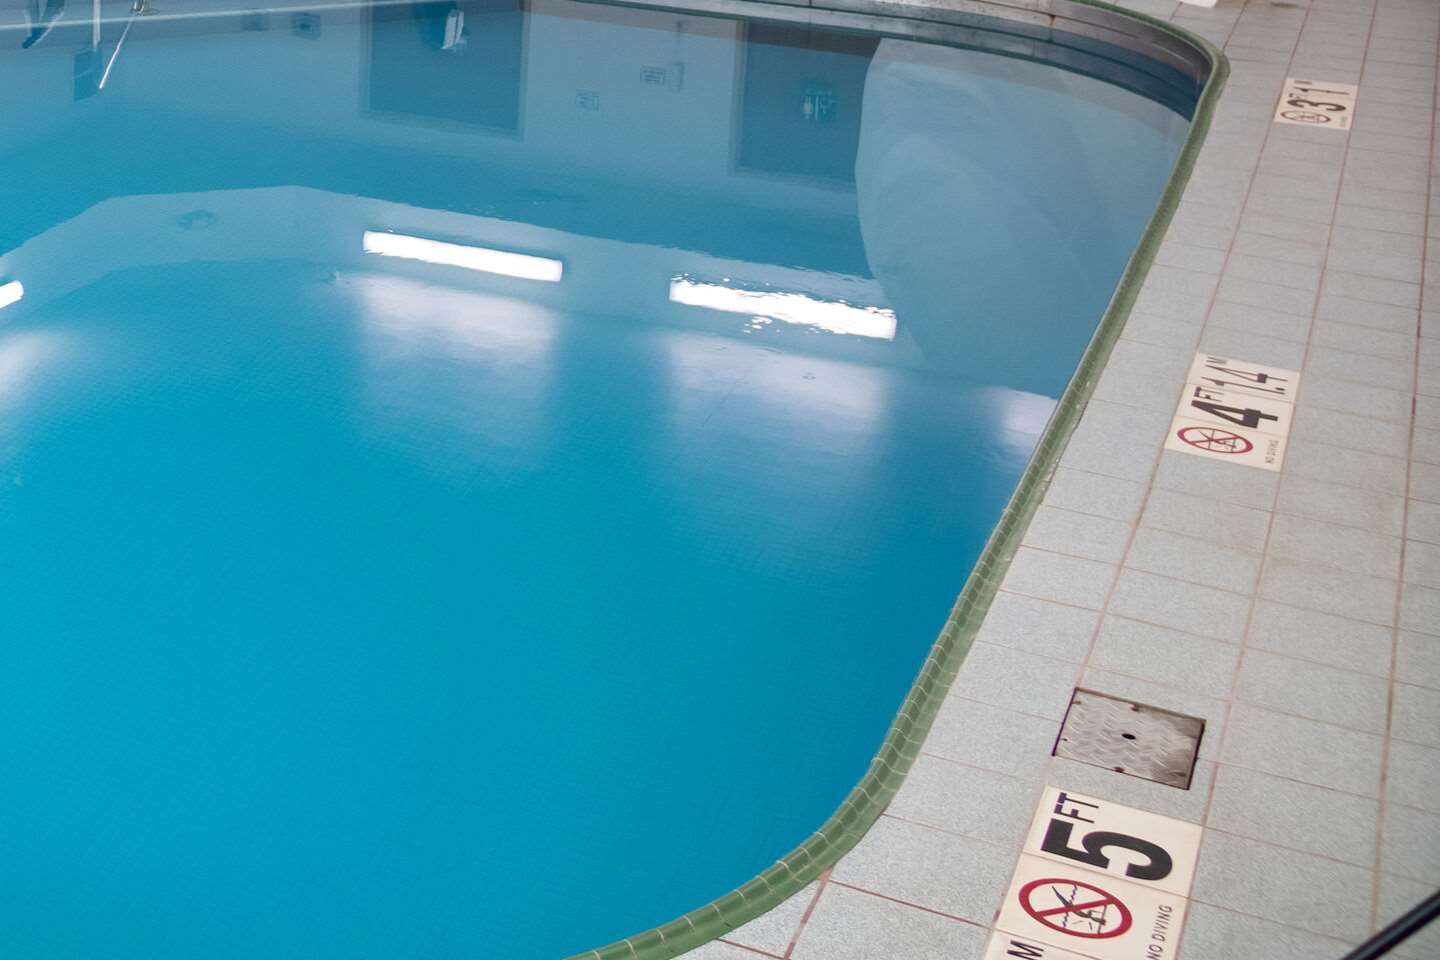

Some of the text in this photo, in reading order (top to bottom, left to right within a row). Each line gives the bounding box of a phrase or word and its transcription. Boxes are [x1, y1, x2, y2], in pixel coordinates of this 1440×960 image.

[1190, 399, 1279, 429] 4
[1040, 792, 1173, 881] 5 FT
[1151, 904, 1173, 943] DIVING
